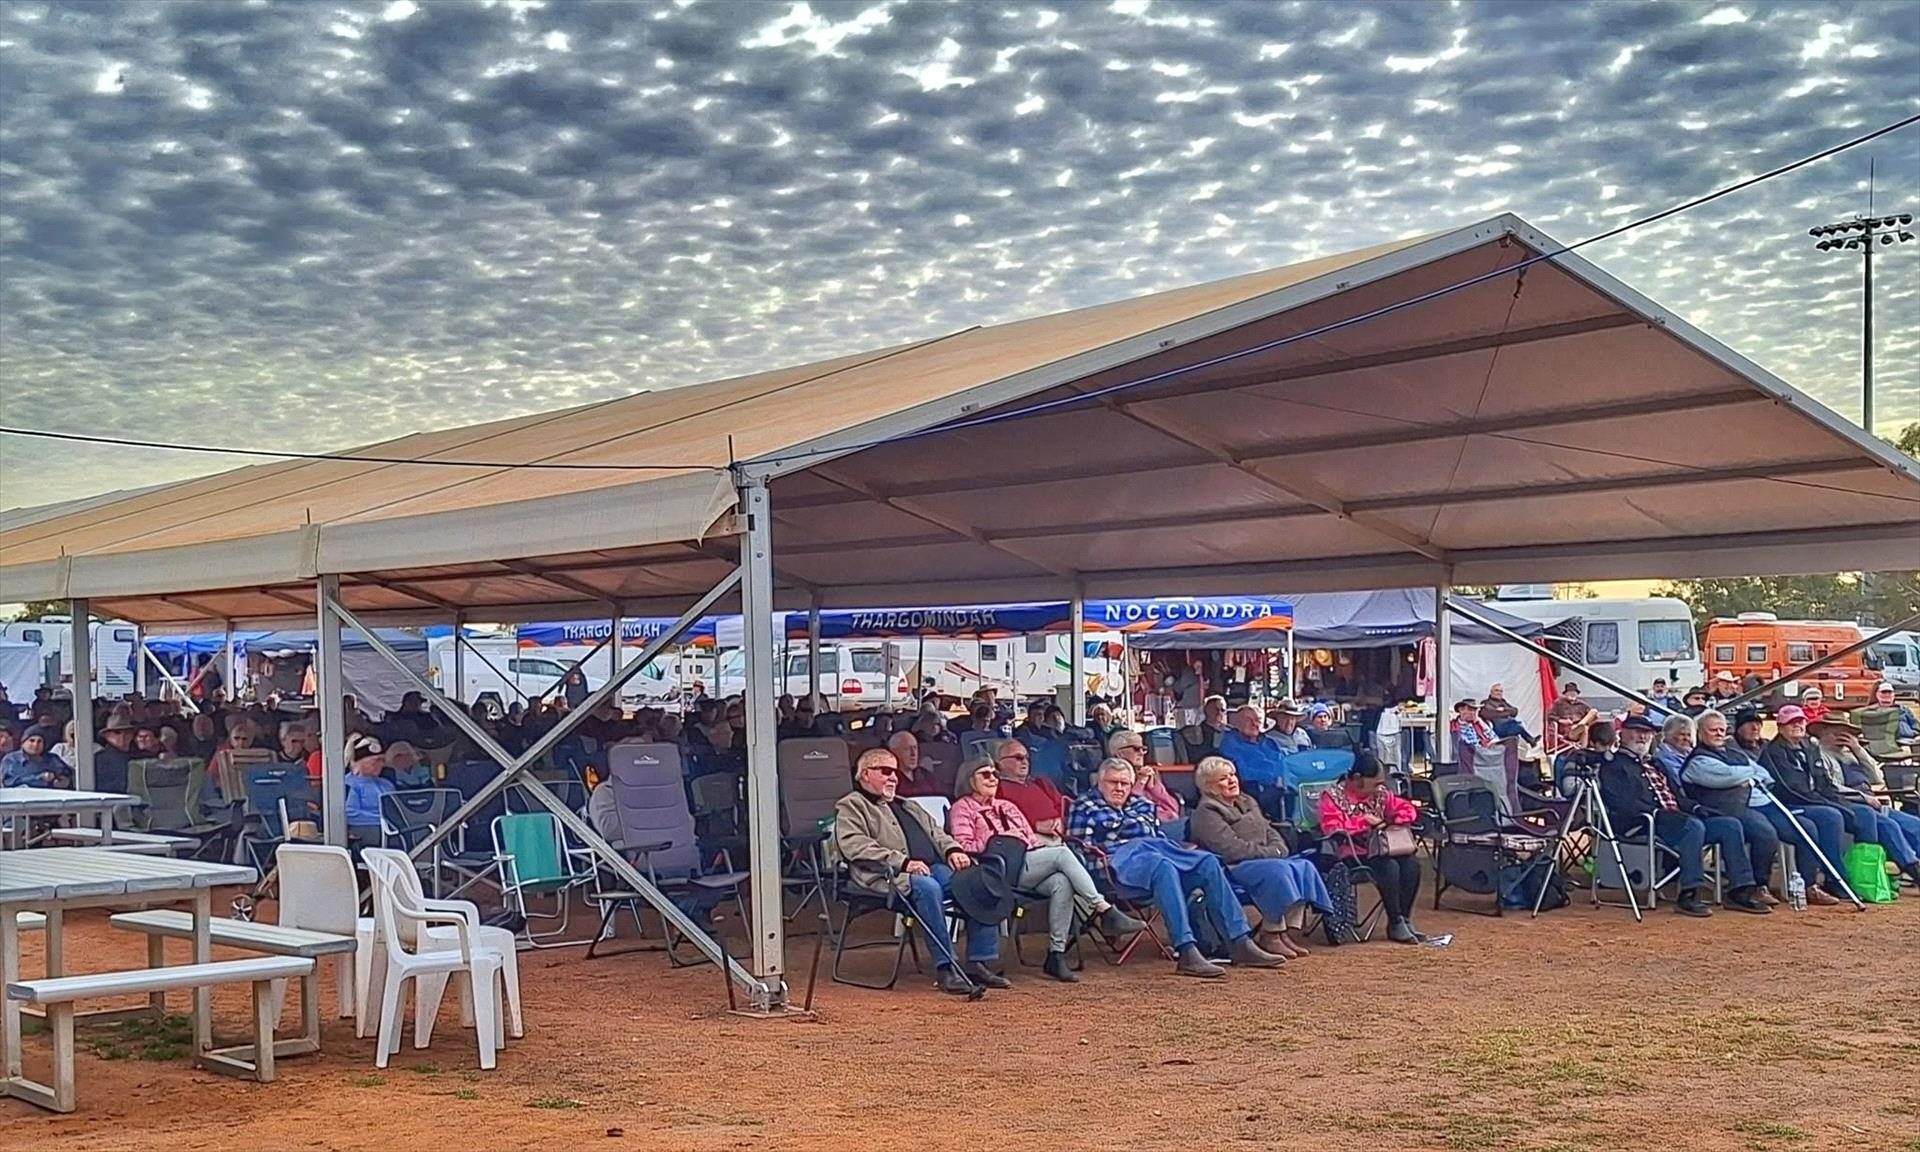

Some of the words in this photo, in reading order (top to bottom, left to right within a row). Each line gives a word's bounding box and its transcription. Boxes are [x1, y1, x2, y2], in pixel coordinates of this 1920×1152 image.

[851, 608, 996, 629] THARGOMINDAH
[1105, 603, 1272, 620] NOCCUNDRA
[563, 623, 660, 639] THARGOINDAH
